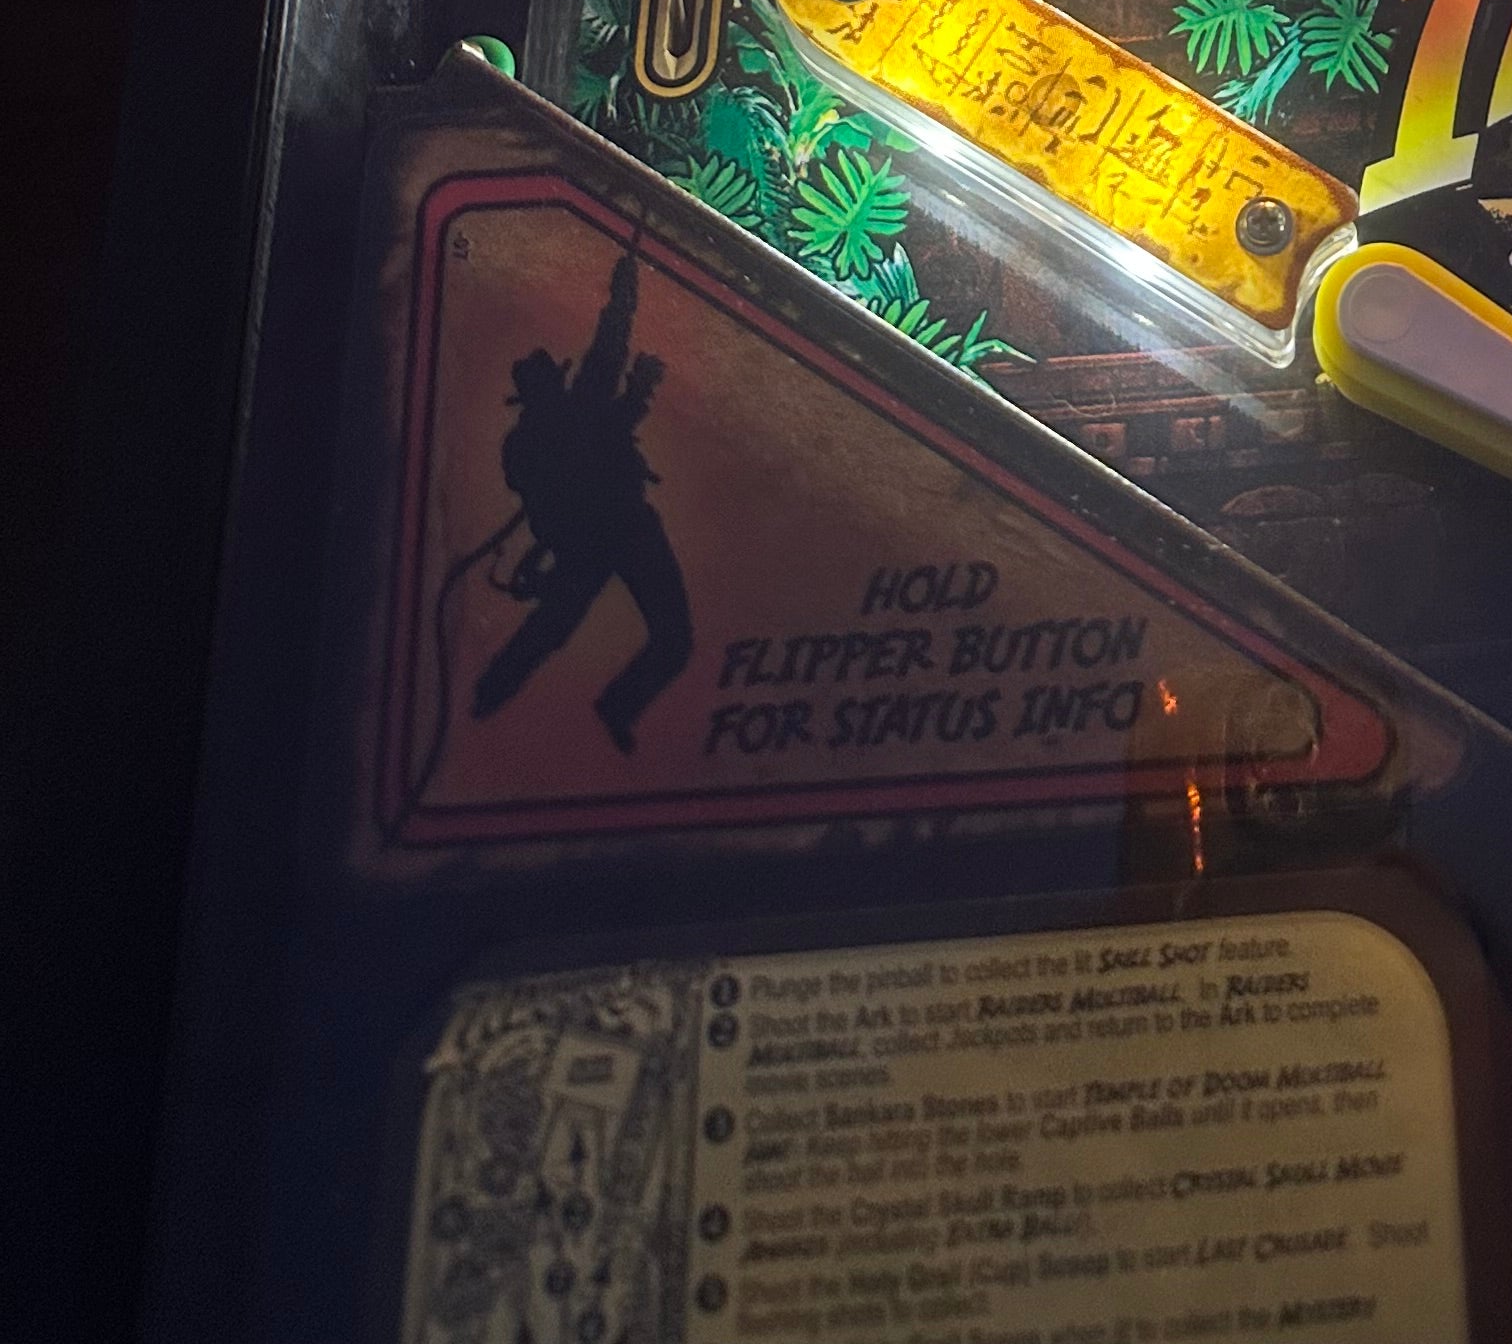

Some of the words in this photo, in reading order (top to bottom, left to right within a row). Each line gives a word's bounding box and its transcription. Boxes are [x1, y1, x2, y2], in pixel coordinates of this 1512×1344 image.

[862, 560, 999, 616] HOLD
[717, 627, 937, 689] FLIPPER
[948, 618, 1149, 676] BUTTON
[703, 700, 815, 755] FOR
[828, 687, 1003, 748] STATUS
[1013, 680, 1145, 739] INFO
